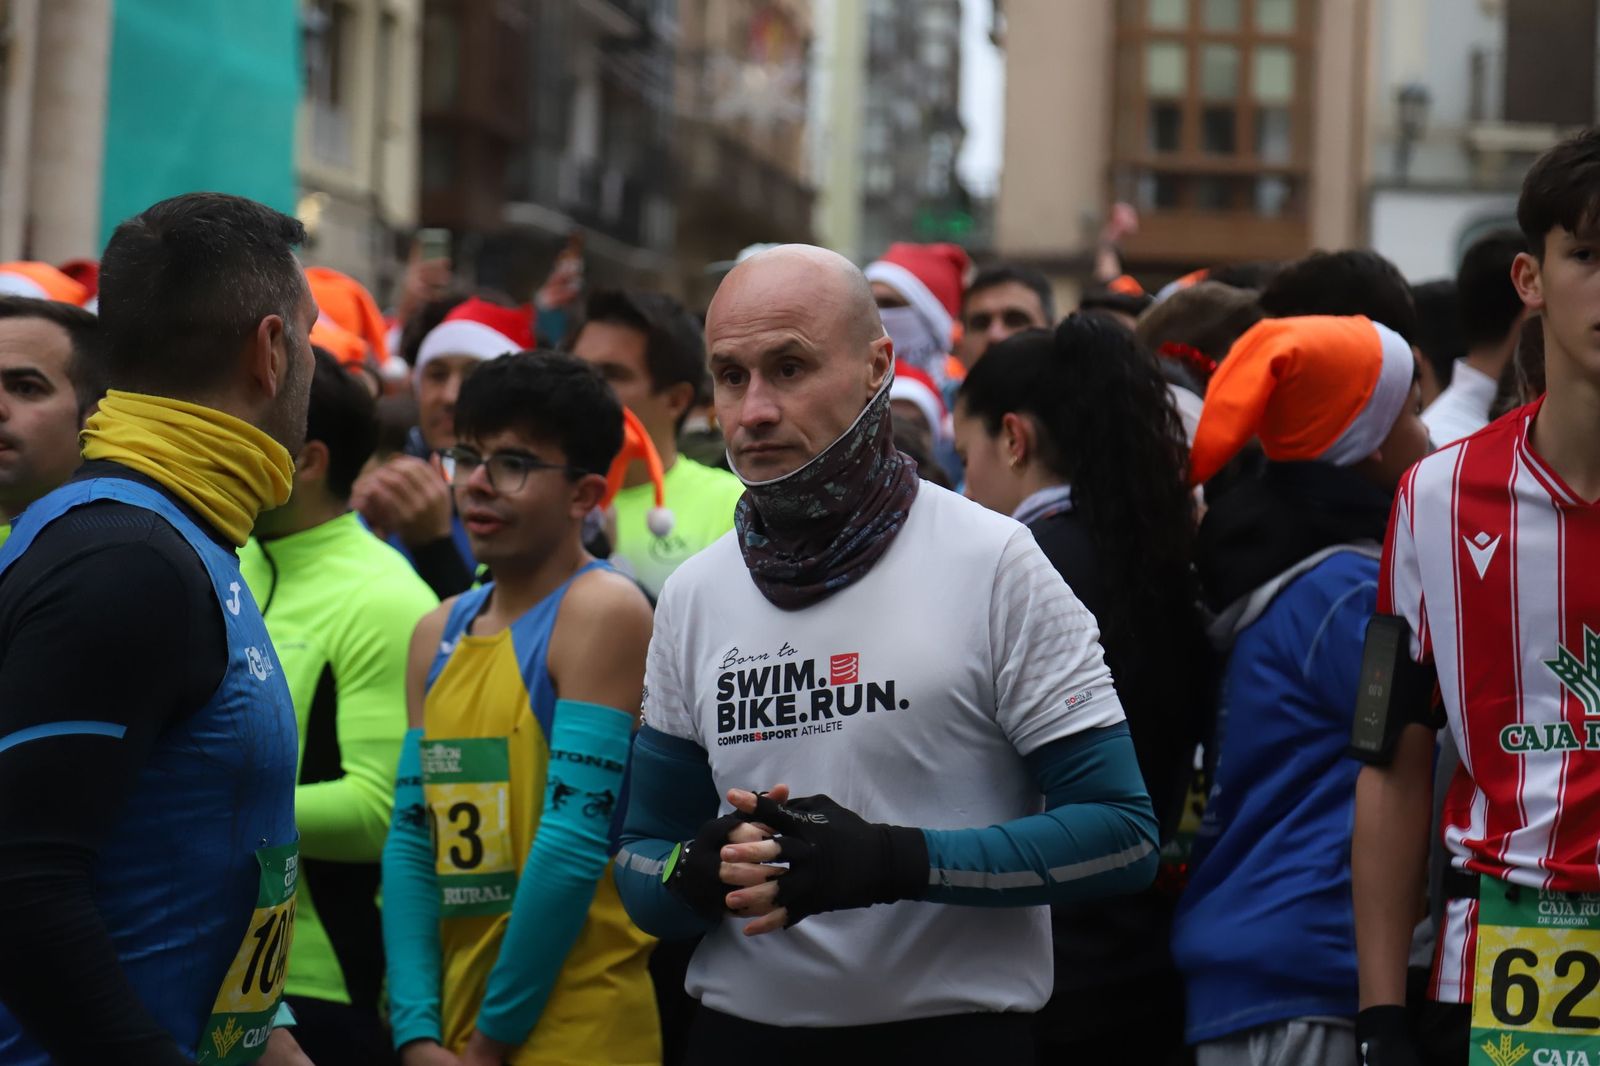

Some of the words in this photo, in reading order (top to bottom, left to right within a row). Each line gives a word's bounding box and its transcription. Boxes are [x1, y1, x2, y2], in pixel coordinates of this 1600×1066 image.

[718, 646, 770, 670] Born
[777, 642, 798, 658] to
[716, 659, 827, 702] SWIM.
[717, 728, 798, 746] COMPRESSPORT
[801, 721, 843, 736] ATHLETE
[1500, 723, 1581, 753] CAJA
[443, 885, 511, 905] RURAL
[1538, 901, 1576, 916] CAJA
[1537, 916, 1550, 925] DE
[1552, 916, 1590, 926] ZAMORA
[1532, 1048, 1594, 1066] CAJA
